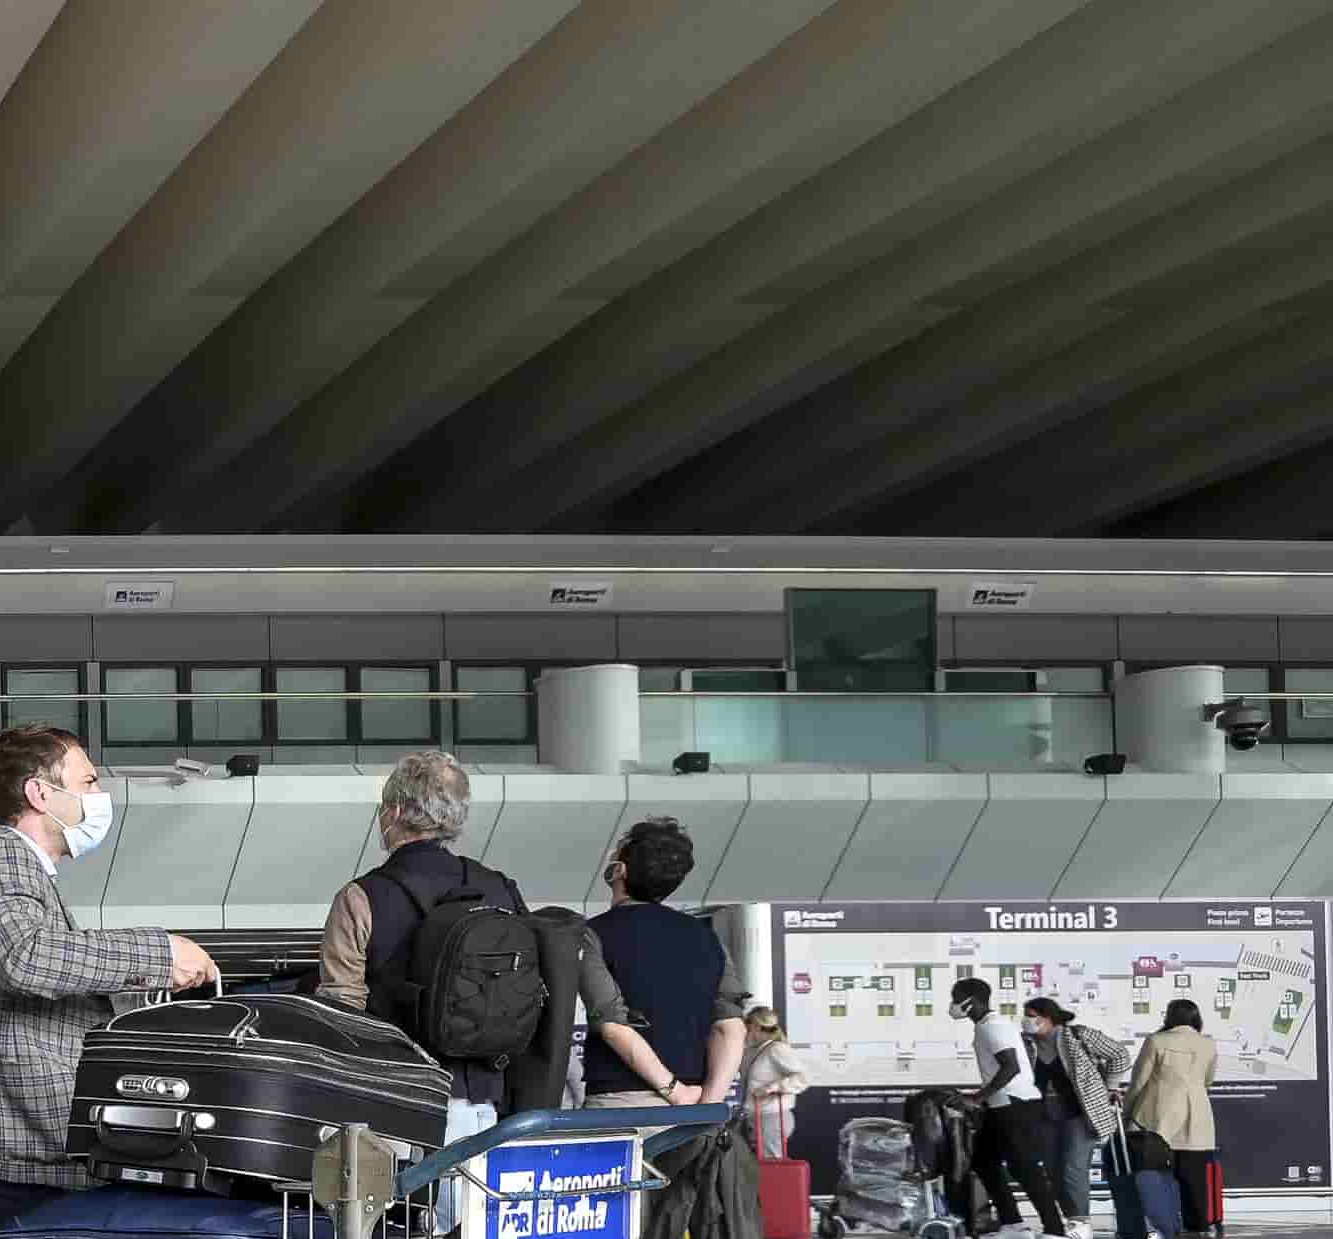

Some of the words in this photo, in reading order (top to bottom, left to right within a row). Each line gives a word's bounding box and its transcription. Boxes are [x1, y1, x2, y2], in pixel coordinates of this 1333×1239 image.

[985, 904, 1095, 929] Terminal
[1102, 906, 1118, 929] 3
[540, 1165, 623, 1193] Aeroporti
[537, 1198, 554, 1236] di
[557, 1200, 609, 1234] Roma
